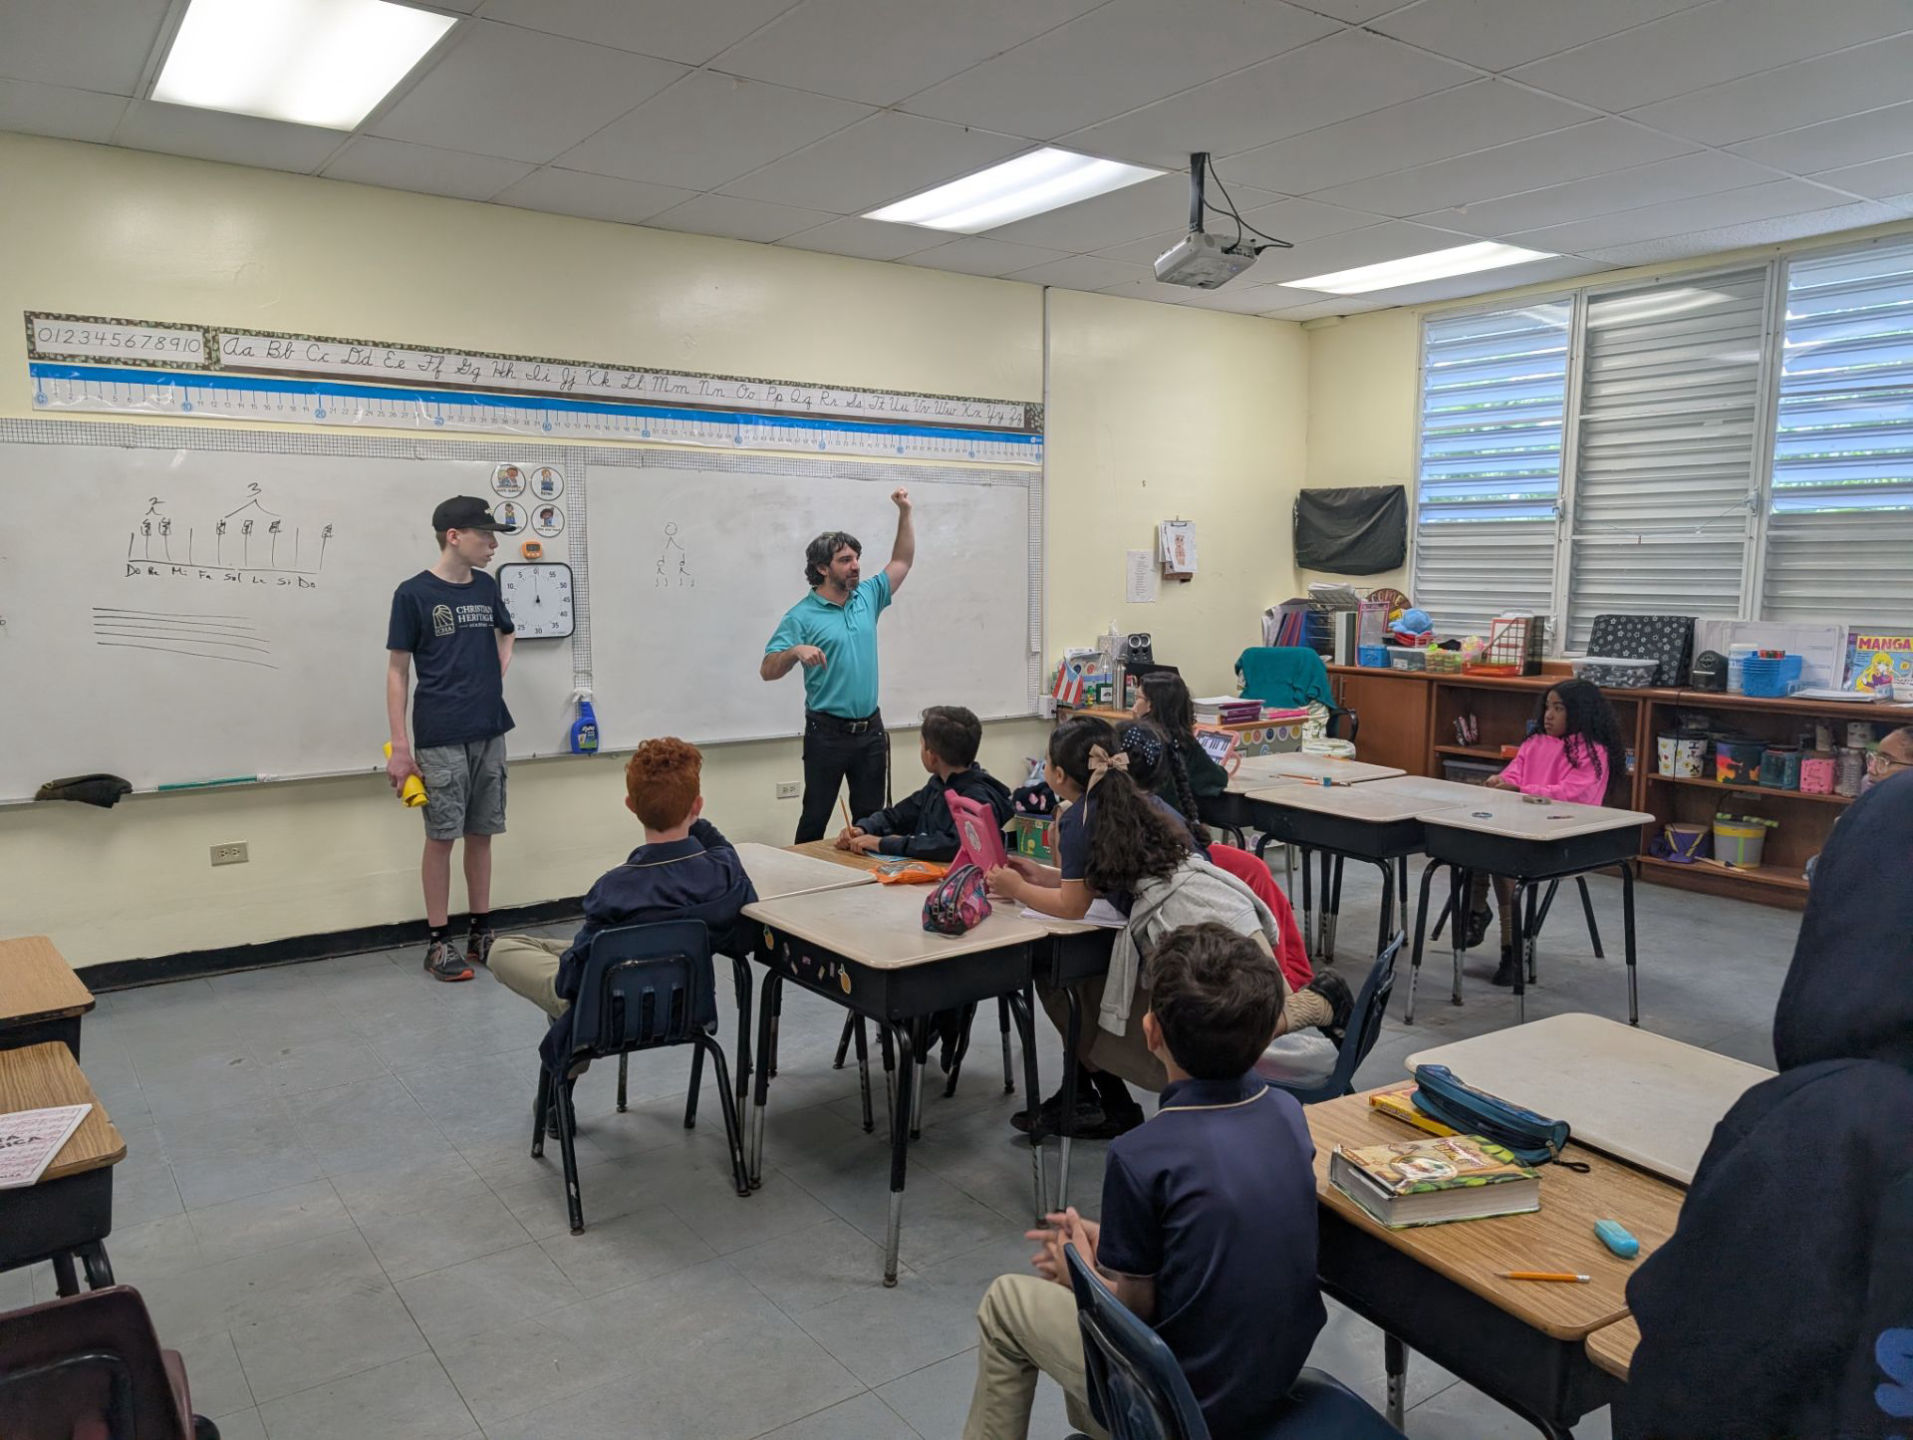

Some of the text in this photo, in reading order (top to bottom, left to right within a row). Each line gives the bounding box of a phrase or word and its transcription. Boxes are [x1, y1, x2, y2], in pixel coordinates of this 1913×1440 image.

[223, 337, 1023, 426] Aa Bb Cc Dd Ee Ff Gg Hh Ii Jj Kk Ll Mm Nn Oo Pp Qq Rr Ss Tt Uu Vv Ww Xx Yy Zz
[124, 563, 140, 578] Do
[298, 576, 316, 589] Do
[1858, 637, 1911, 650] MANGA
